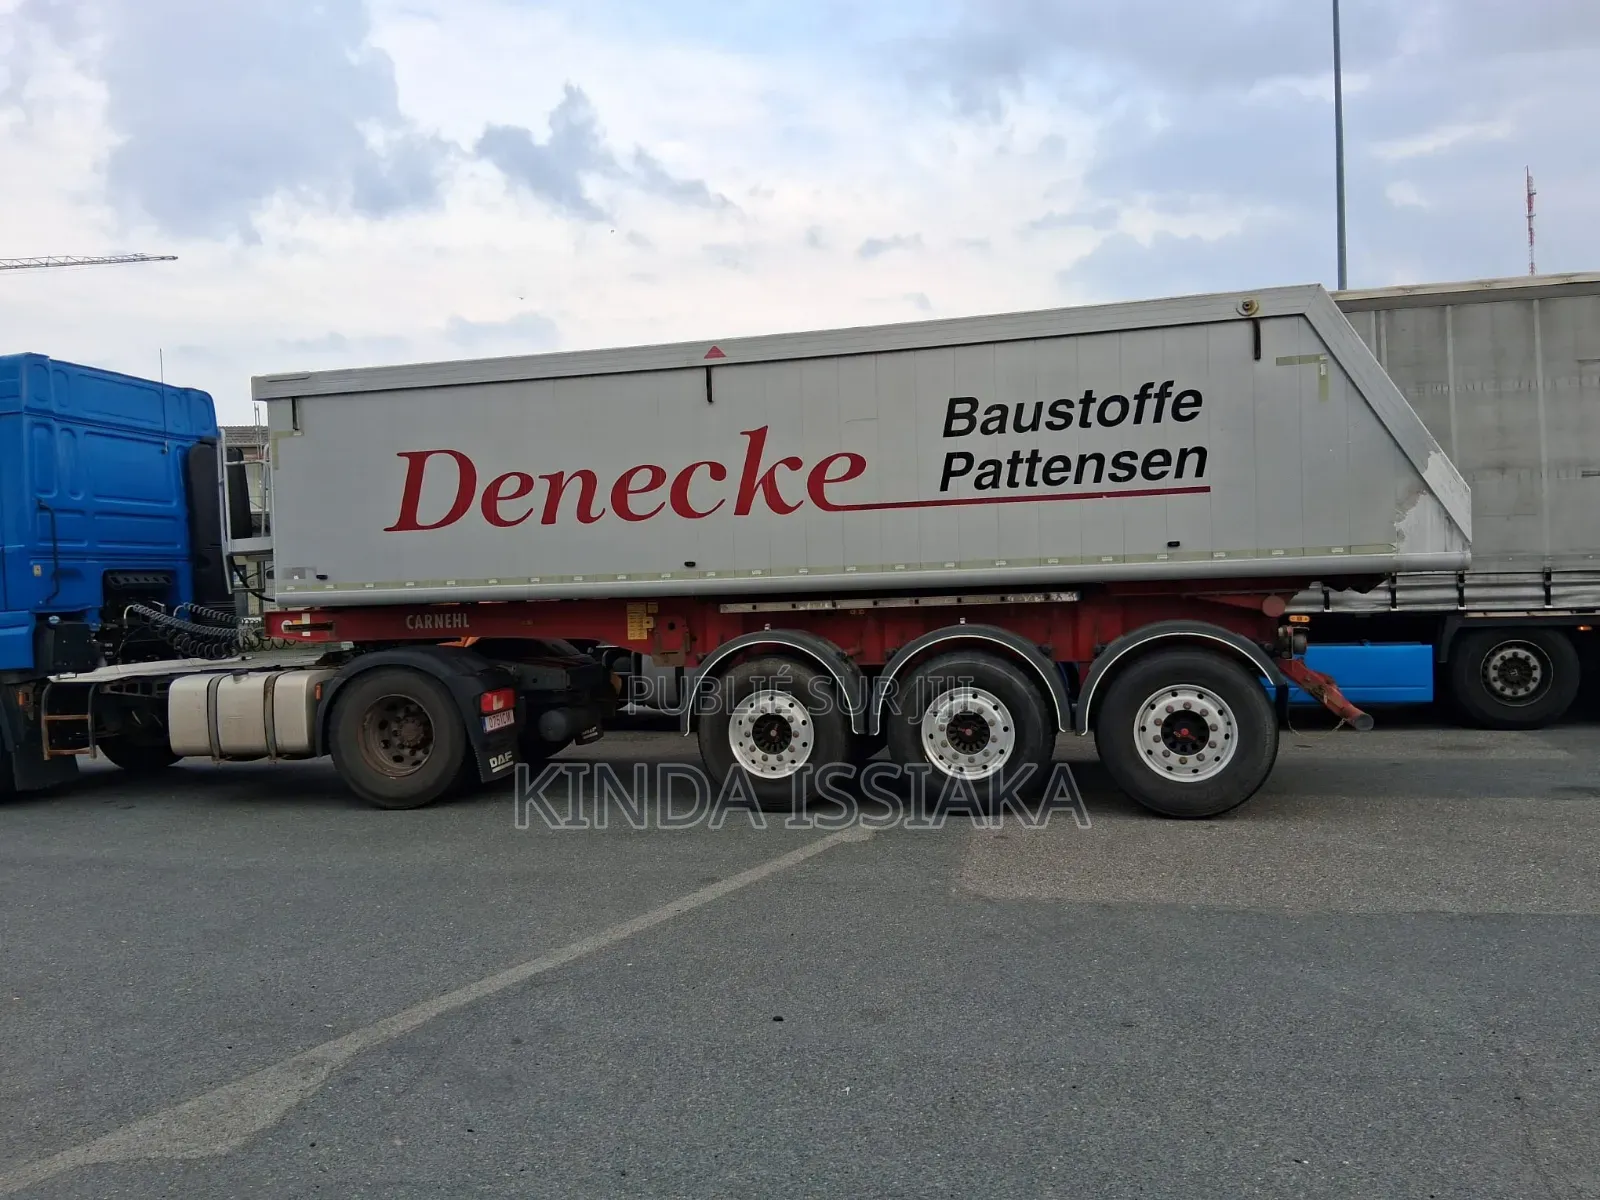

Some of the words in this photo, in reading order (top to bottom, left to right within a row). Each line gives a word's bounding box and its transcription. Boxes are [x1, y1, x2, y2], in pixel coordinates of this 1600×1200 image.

[943, 380, 1203, 437] Baustoffe
[384, 427, 867, 531] Denecke
[940, 445, 1208, 491] Pattensen
[405, 612, 470, 630] CARNEHL
[489, 751, 513, 768] DAF
